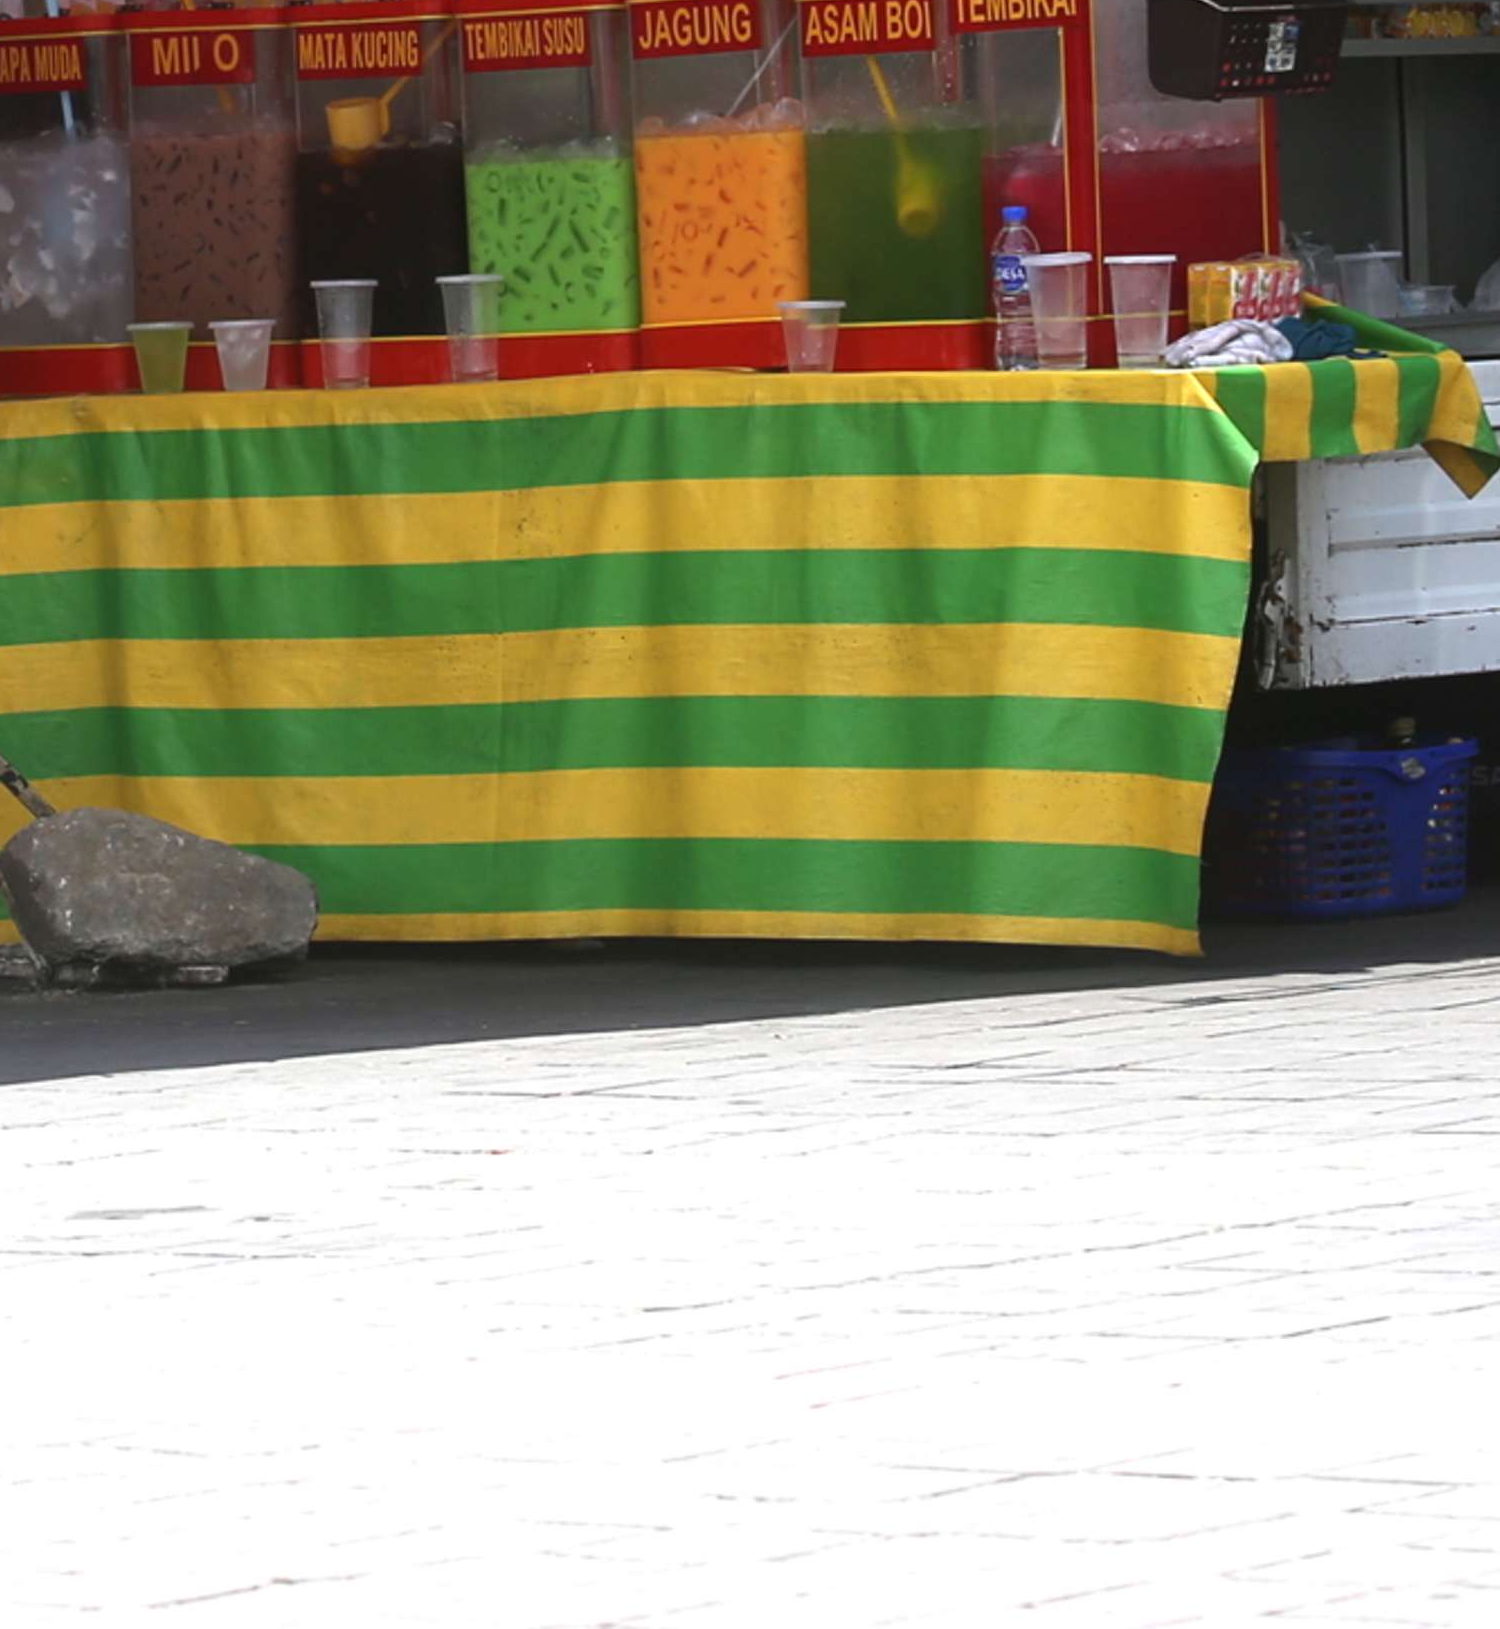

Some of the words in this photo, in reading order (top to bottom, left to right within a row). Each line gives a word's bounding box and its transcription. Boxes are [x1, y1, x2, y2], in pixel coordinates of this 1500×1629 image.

[464, 19, 541, 60] TEMBIKAI
[542, 16, 586, 56] SUSU
[638, 2, 752, 50] JAGUNG
[805, 2, 878, 46] ASAM
[886, 0, 932, 40] BOI
[33, 44, 83, 82] MUDA
[299, 32, 348, 70] MATA
[351, 29, 419, 69] KUCING
